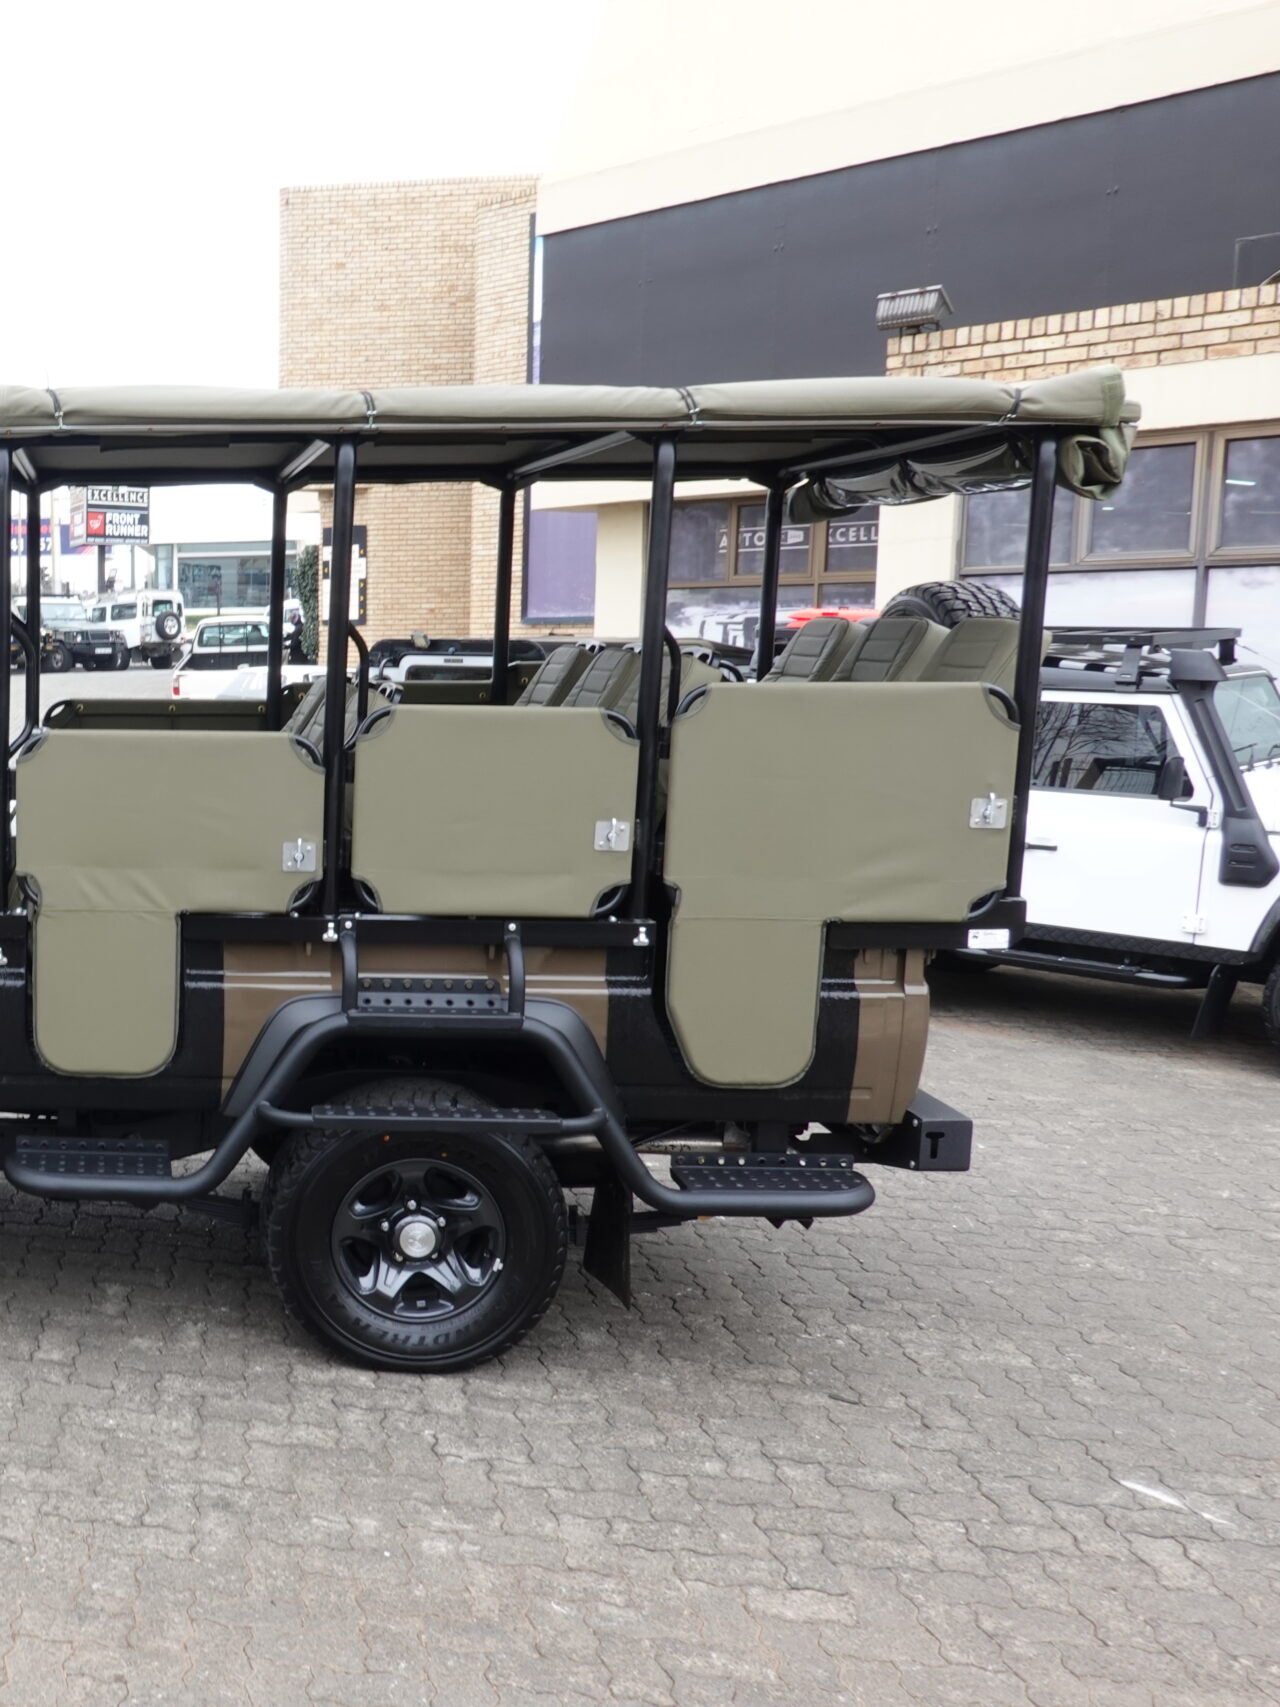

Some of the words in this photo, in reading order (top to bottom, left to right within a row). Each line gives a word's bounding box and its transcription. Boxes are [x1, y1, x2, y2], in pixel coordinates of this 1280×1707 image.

[106, 512, 140, 525] FRONT
[105, 524, 148, 537] RUNNER
[719, 532, 766, 548] ATO
